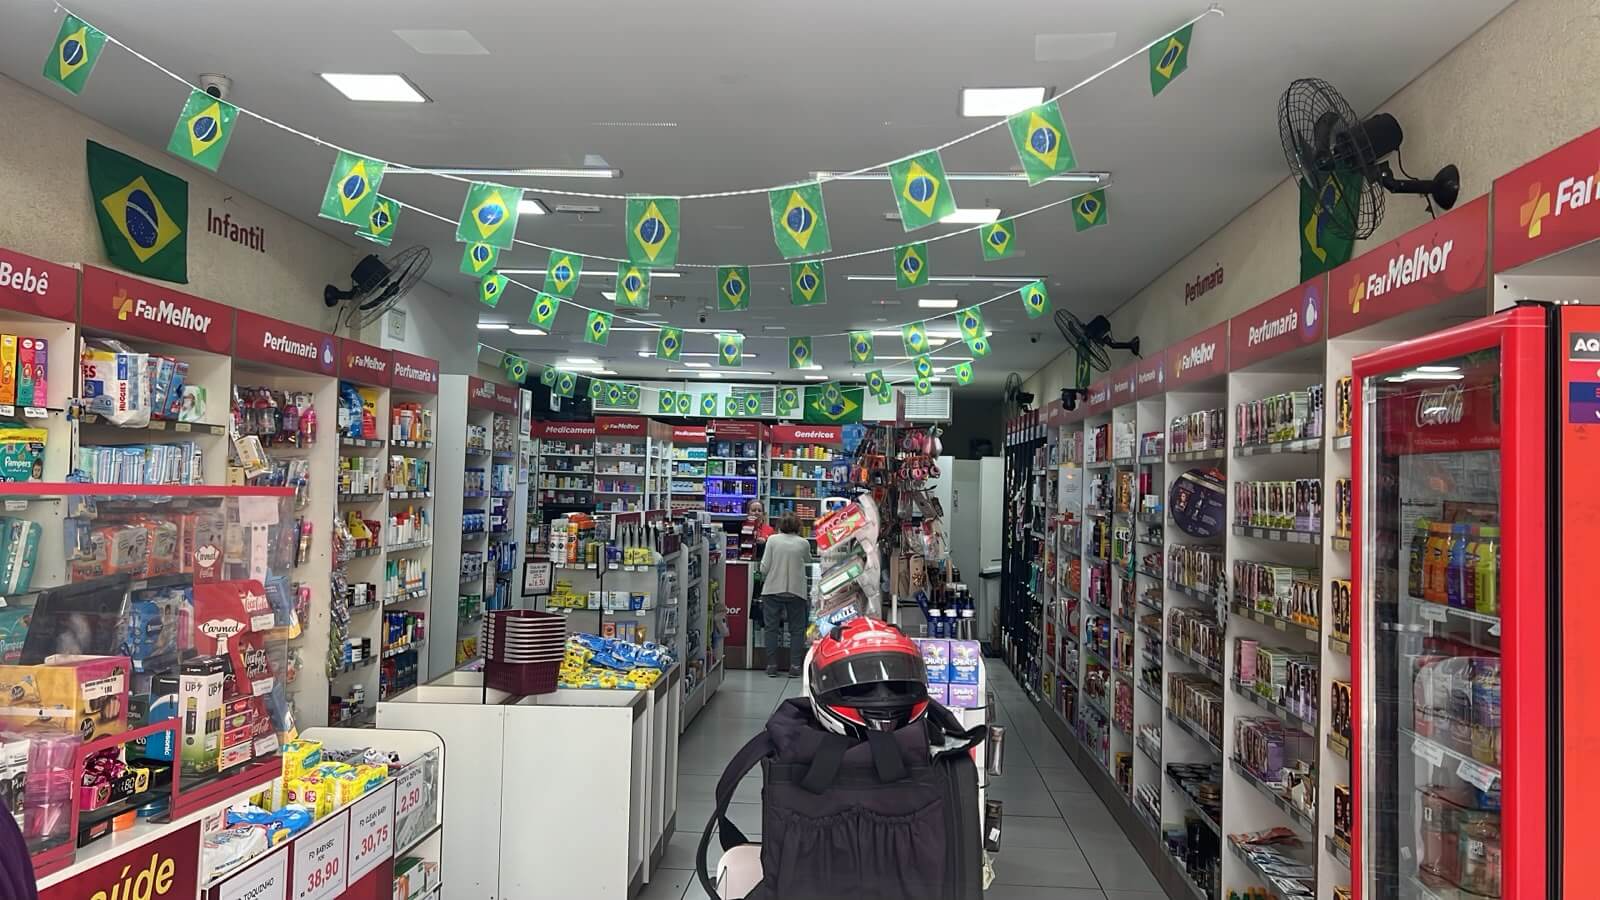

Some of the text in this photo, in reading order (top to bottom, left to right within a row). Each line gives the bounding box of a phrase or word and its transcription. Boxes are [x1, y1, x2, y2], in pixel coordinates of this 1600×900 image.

[207, 207, 265, 253] Infantil
[0, 261, 49, 295] Bebê
[1366, 239, 1453, 300] FarMelhor
[1184, 262, 1224, 306] Perfumaria
[135, 298, 212, 333] FarMelhor
[1248, 307, 1298, 347] Perfumaria
[263, 332, 318, 359] Perfumaria
[1181, 342, 1215, 370] FarMelhor
[354, 354, 386, 372] FarMelhor
[394, 362, 431, 382] Perfumaria
[794, 430, 834, 439] Genéricos
[5, 456, 31, 468] Pampers
[202, 621, 239, 633] Carmed
[830, 604, 856, 624] HALLS
[185, 682, 196, 692] UP
[208, 686, 218, 697] UP
[164, 728, 172, 756] asonic
[401, 787, 420, 813] 2,50
[361, 824, 388, 857] 30,75
[307, 856, 339, 893] 38,90
